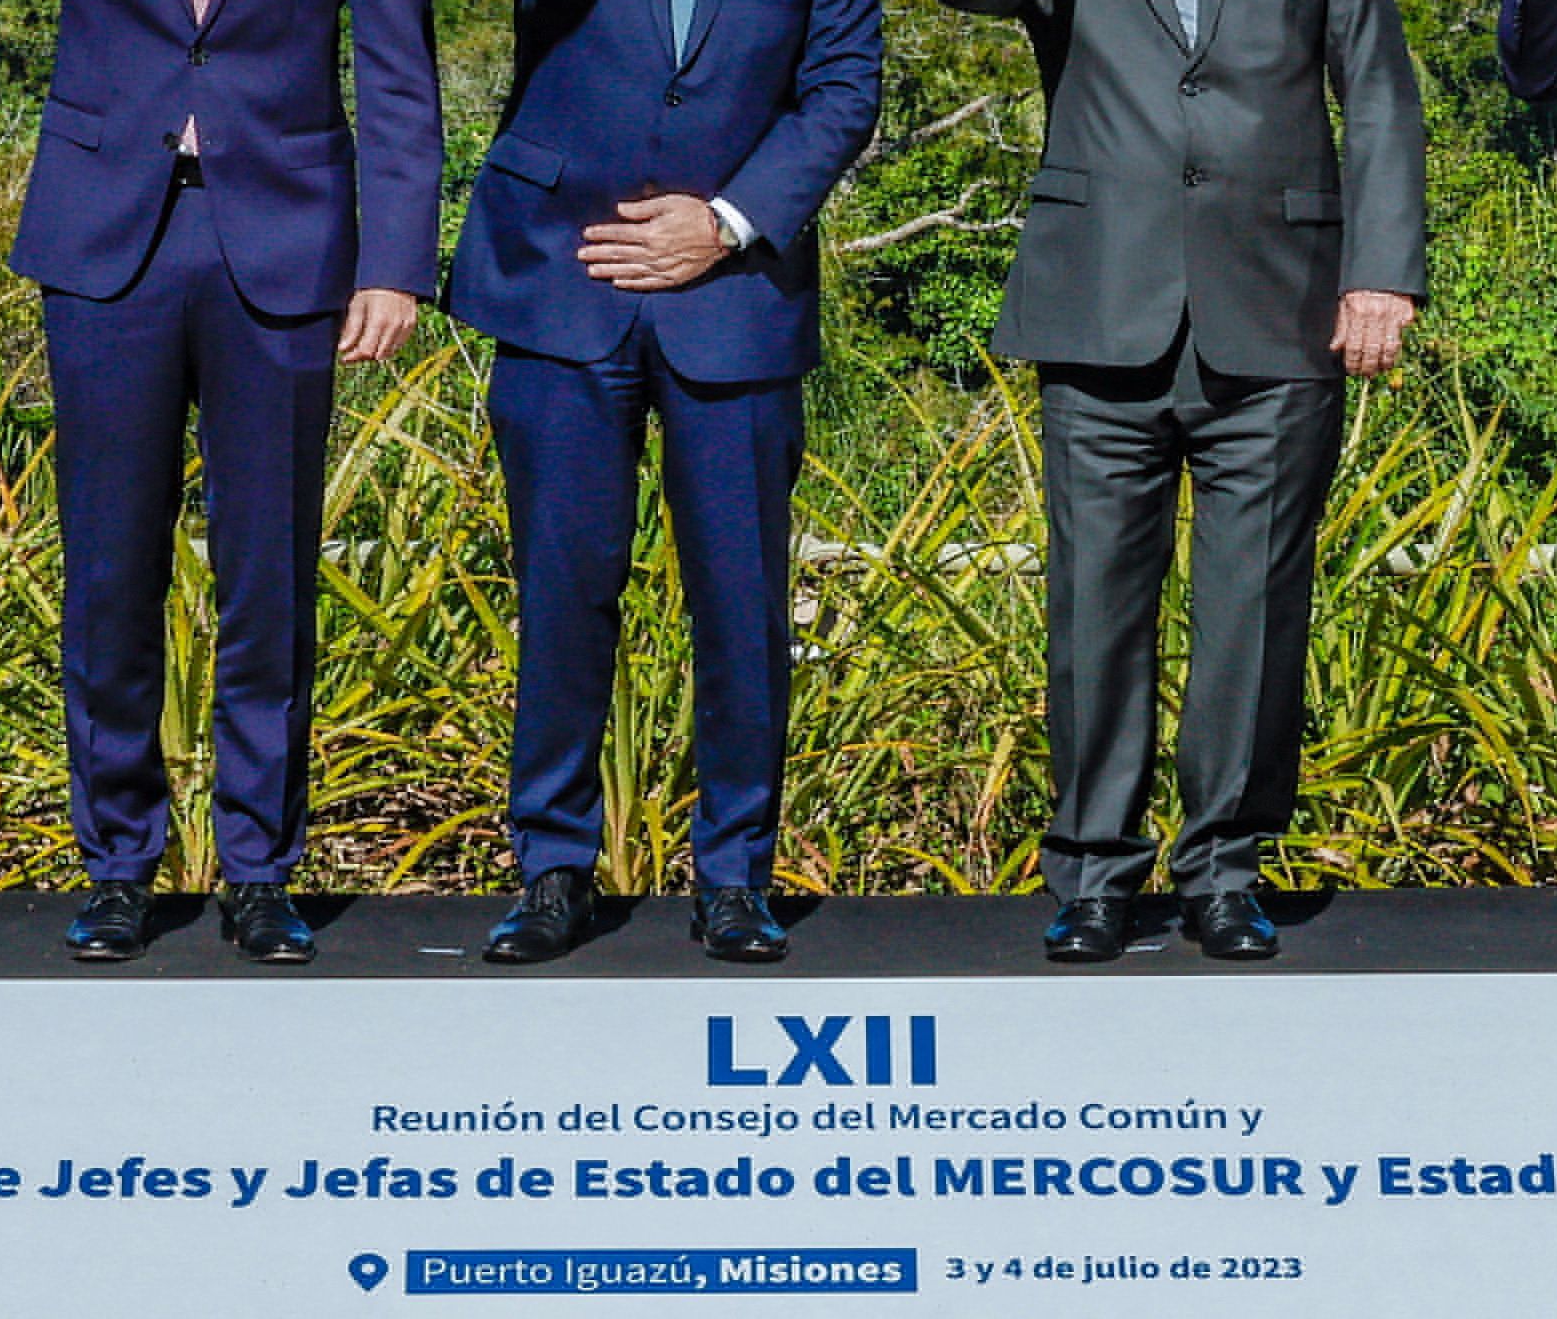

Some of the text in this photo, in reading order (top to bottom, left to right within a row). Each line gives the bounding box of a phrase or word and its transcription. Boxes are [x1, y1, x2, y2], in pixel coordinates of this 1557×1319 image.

[707, 1016, 936, 1087] LXII
[373, 1098, 1262, 1139] Reunión del Consejo del Mercado Común y
[38, 1157, 212, 1199] Jefes
[231, 1168, 268, 1209] y
[285, 1157, 458, 1199] Jefas
[476, 1157, 554, 1199] de
[575, 1157, 794, 1199] Estado
[814, 1156, 916, 1198] del
[935, 1157, 1304, 1197] MERCOSUR
[1322, 1165, 1358, 1206] y
[424, 1253, 902, 1291] Puerto Iguazú, Misiones
[945, 1256, 1303, 1286] 3 y 4 de julio de 2023
